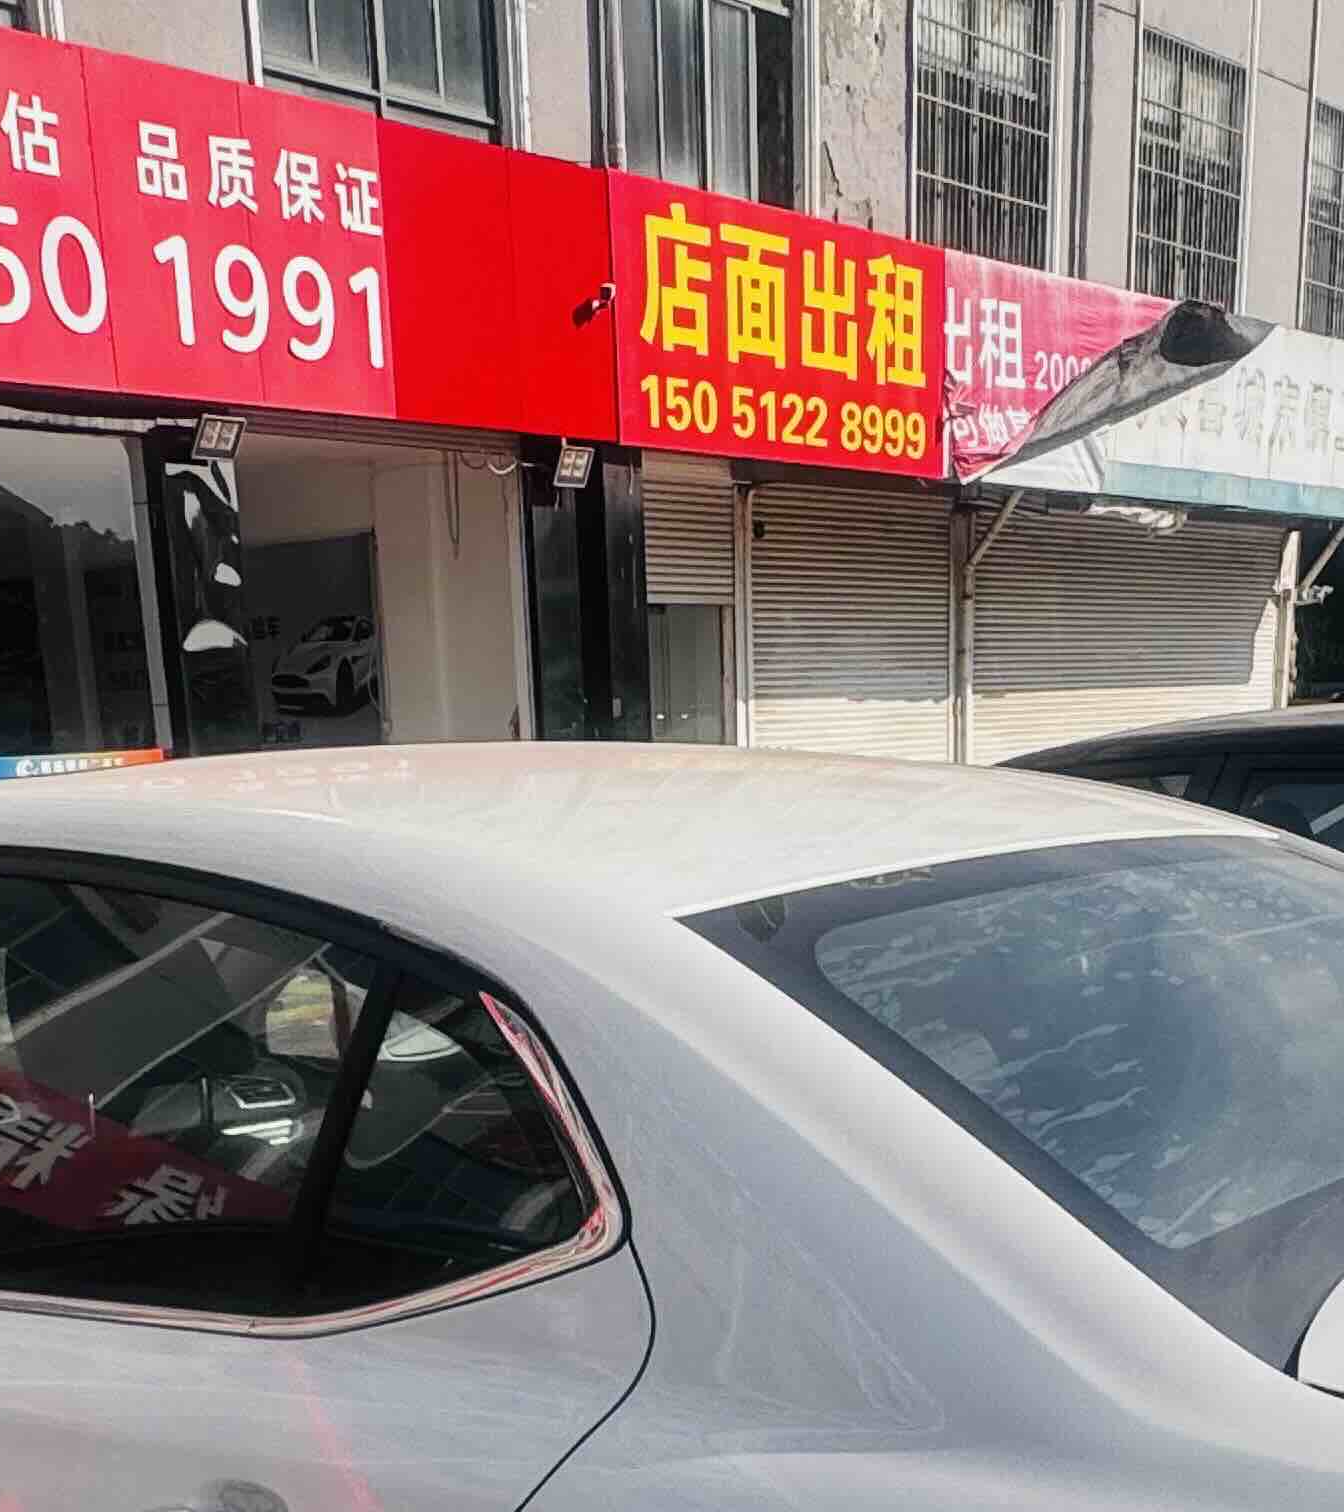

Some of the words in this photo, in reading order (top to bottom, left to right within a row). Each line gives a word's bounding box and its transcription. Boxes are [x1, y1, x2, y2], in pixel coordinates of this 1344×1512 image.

[136, 121, 383, 238] 品质保证
[152, 234, 386, 369] 1991
[640, 203, 926, 388] 店面出租
[641, 374, 718, 434] 150
[732, 385, 828, 447] 5122
[840, 401, 926, 460] 8999
